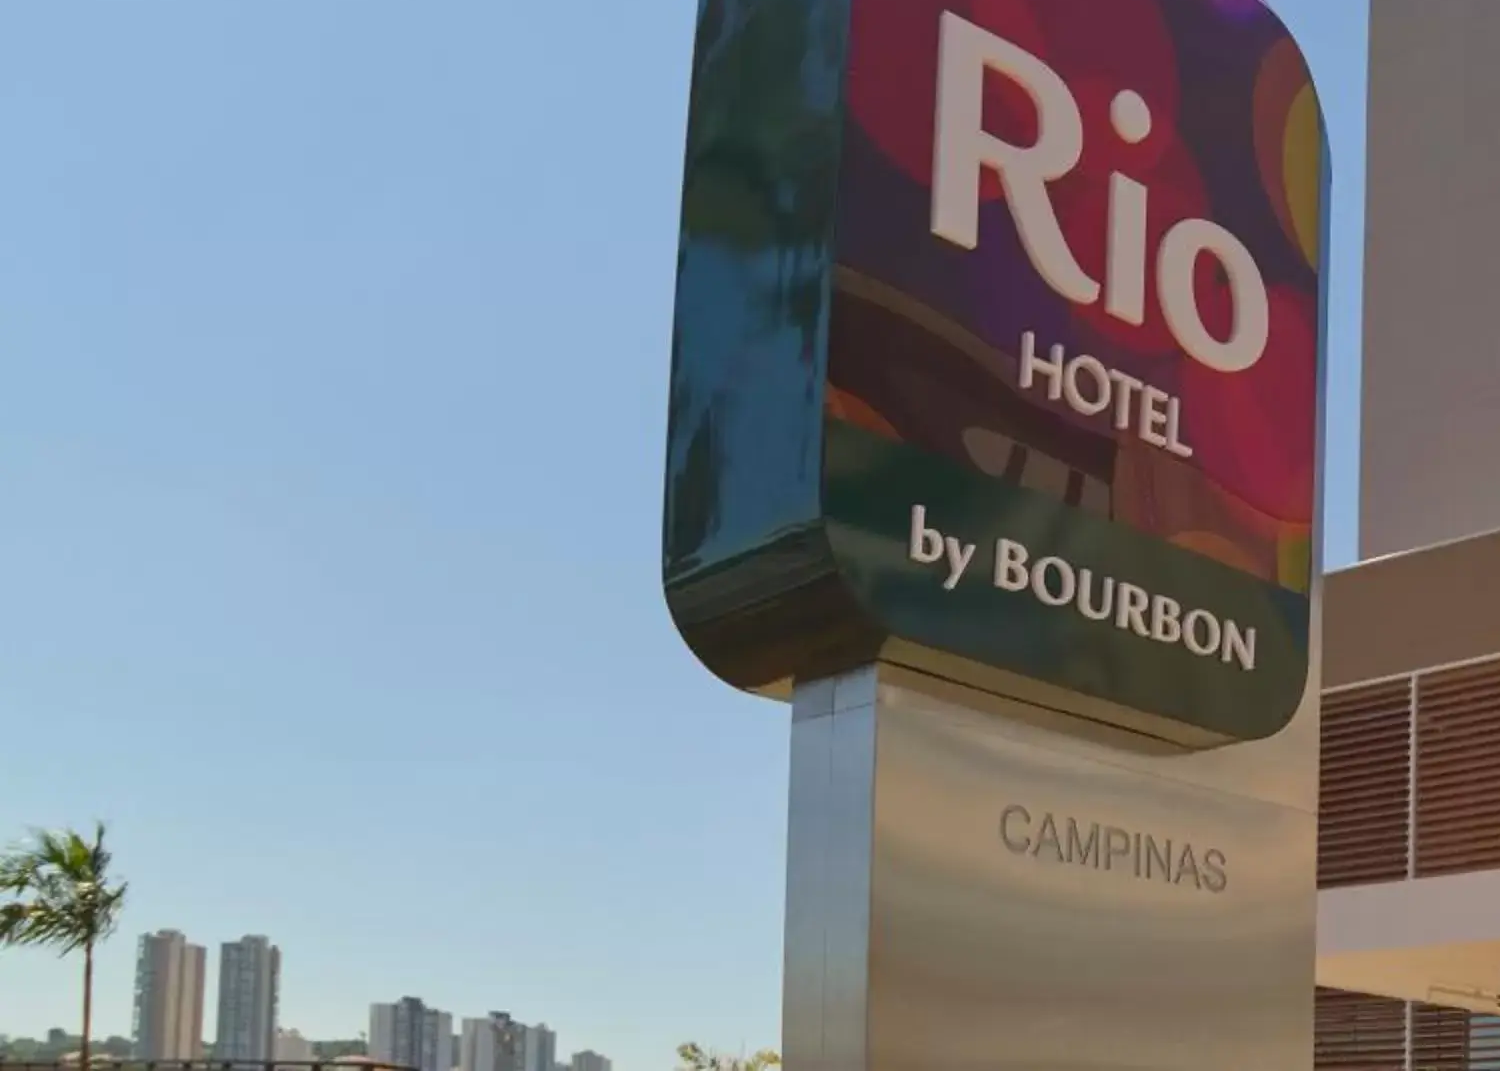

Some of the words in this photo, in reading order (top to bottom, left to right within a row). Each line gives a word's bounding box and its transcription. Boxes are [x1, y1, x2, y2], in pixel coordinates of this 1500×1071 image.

[930, 9, 1269, 372] Rio
[1018, 330, 1193, 457] HOTEL
[909, 504, 976, 590] by
[993, 537, 1257, 671] BOURBON
[999, 804, 1228, 893] CAMPINAS
